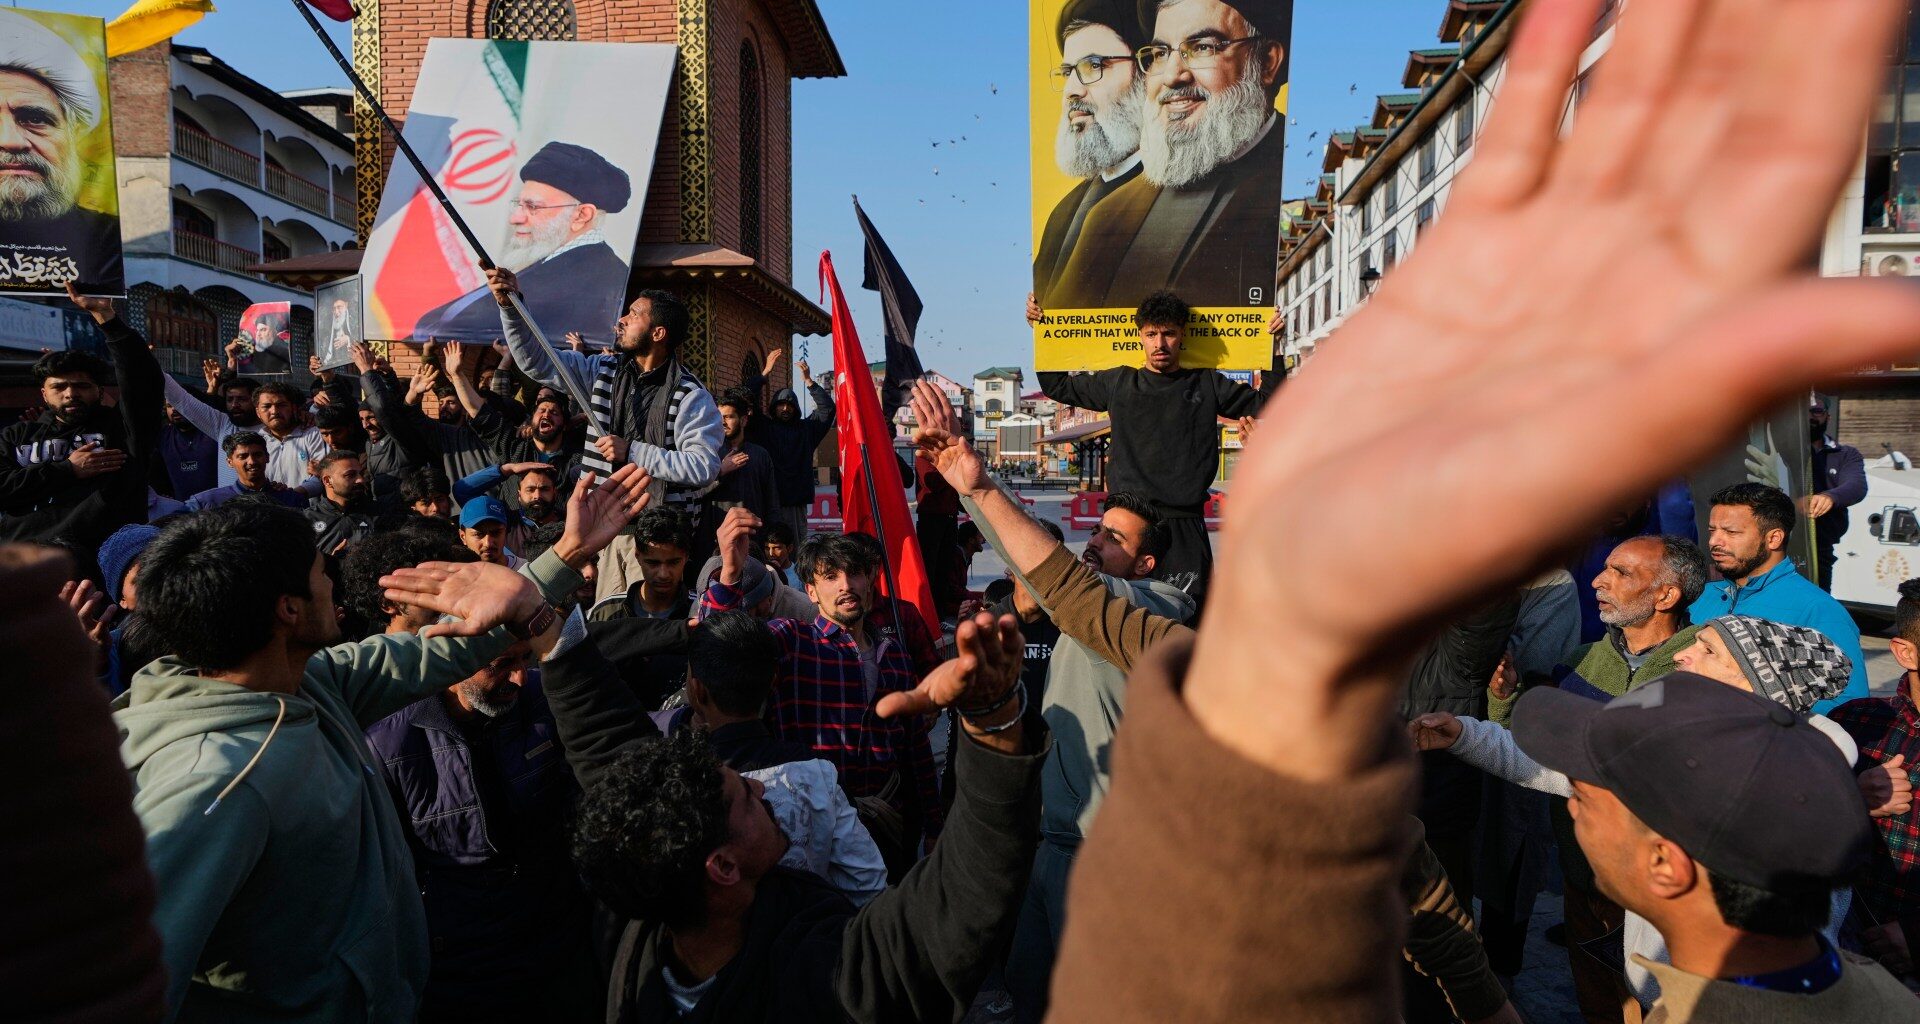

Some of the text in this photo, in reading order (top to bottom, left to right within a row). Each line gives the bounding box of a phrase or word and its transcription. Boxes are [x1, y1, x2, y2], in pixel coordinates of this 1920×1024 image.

[1057, 314, 1128, 325] EVERLASTING
[1199, 313, 1224, 323] ANY
[1225, 313, 1265, 323] OTHER.
[1043, 329, 1051, 338] A
[1053, 328, 1092, 338] COFFIN
[1094, 328, 1121, 337] THAT
[1189, 327, 1209, 337] THE
[1211, 327, 1242, 337] BACK
[1244, 327, 1261, 337] OF
